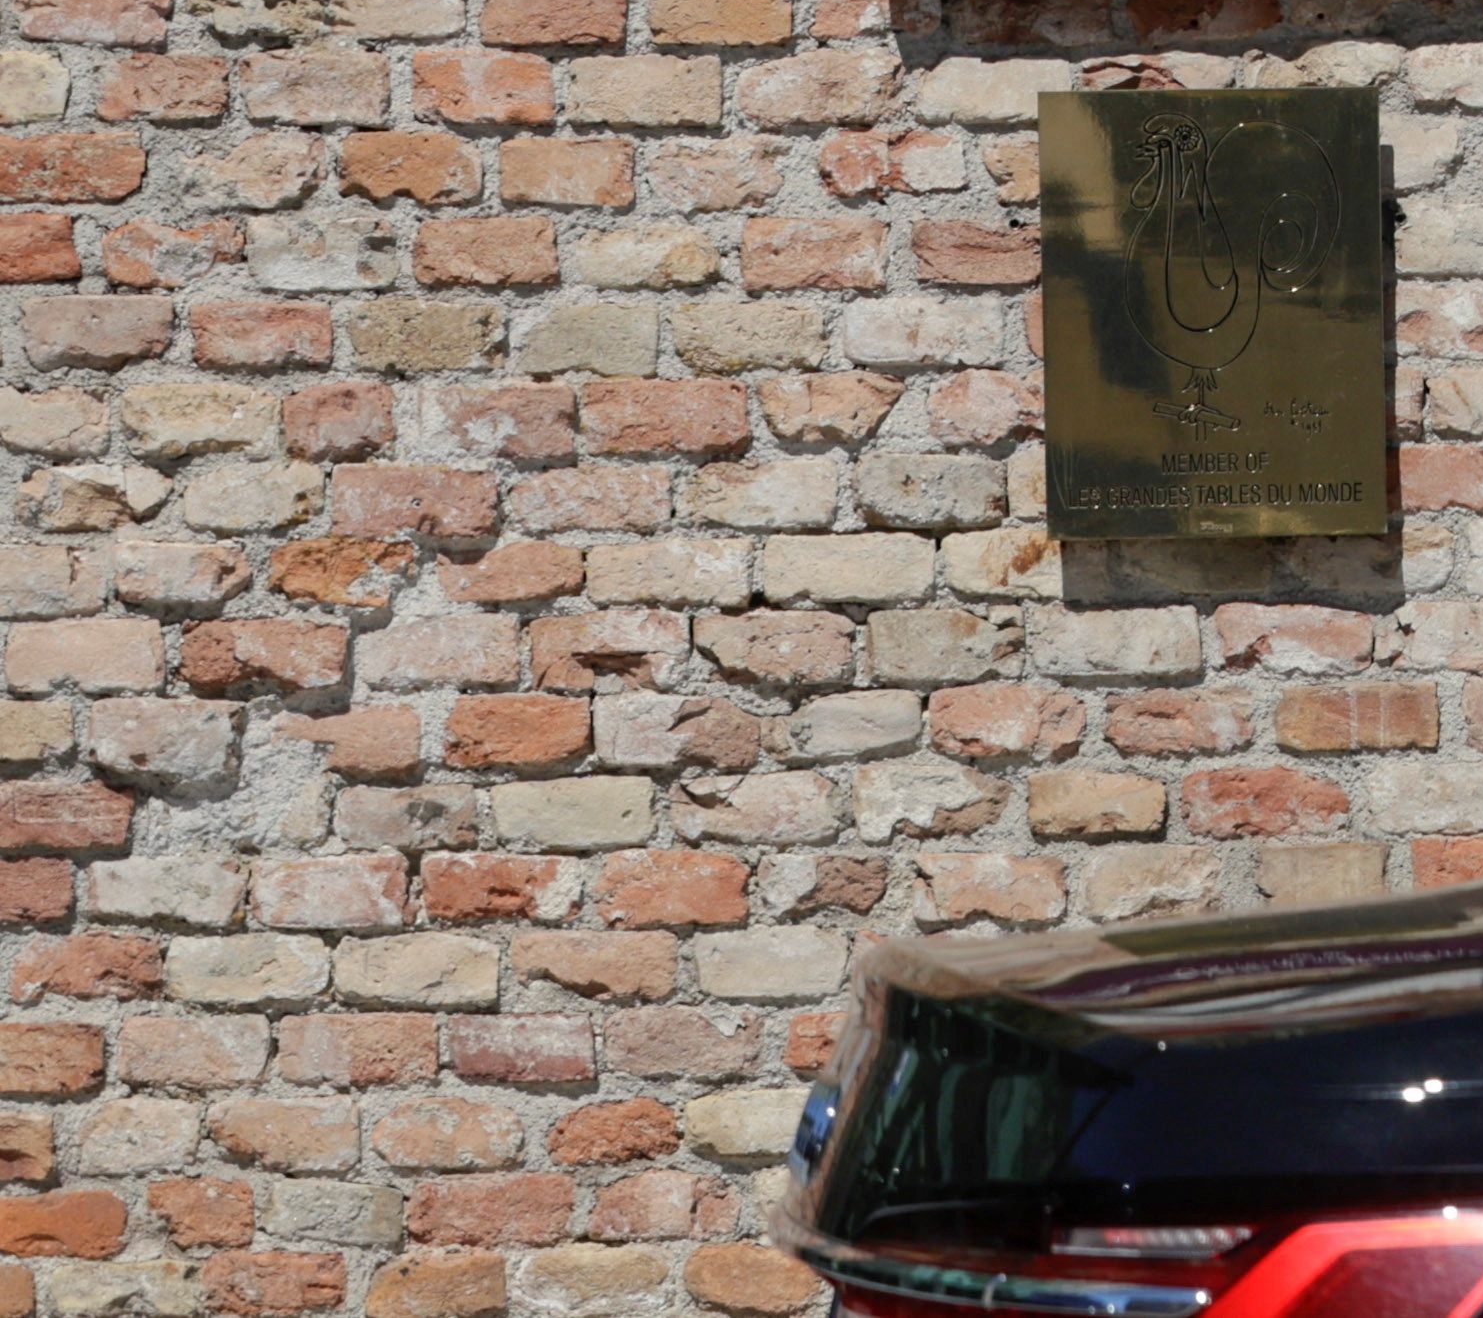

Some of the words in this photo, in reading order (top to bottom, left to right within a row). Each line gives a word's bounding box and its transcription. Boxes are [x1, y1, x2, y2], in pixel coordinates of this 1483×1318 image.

[1161, 453, 1239, 474] MEMBER
[1245, 451, 1270, 474] OF
[1068, 486, 1101, 509] LES
[1106, 485, 1193, 508] GRANDES
[1195, 484, 1262, 506] TABLES
[1267, 483, 1292, 506] DU
[1299, 481, 1363, 505] MONDE
